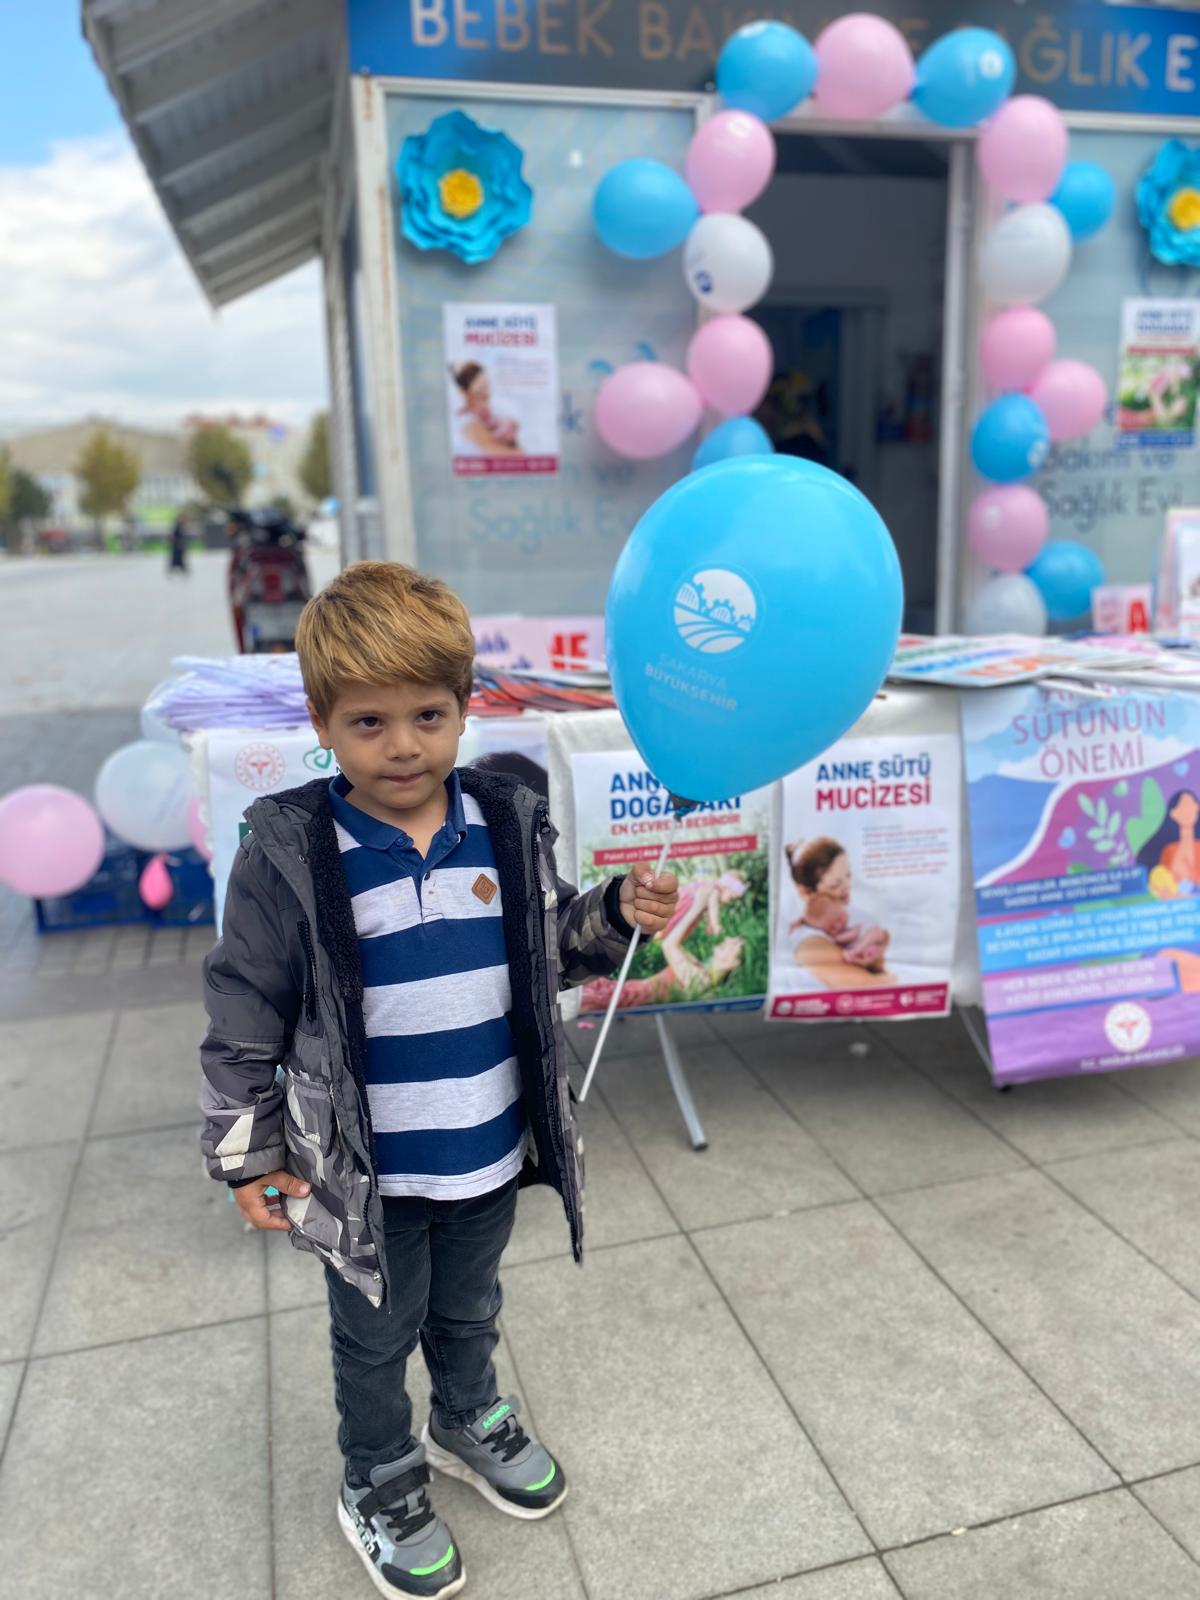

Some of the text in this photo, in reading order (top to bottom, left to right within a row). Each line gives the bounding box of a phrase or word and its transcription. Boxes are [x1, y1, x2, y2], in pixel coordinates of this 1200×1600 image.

[411, 0, 614, 56] BEBEK
[1012, 700, 1166, 746] SÜTÜNÜN
[816, 752, 932, 782] ANNE SÜTÜ
[1040, 738, 1145, 779] ÖNEMİ
[816, 777, 932, 812] MUCİZESİ
